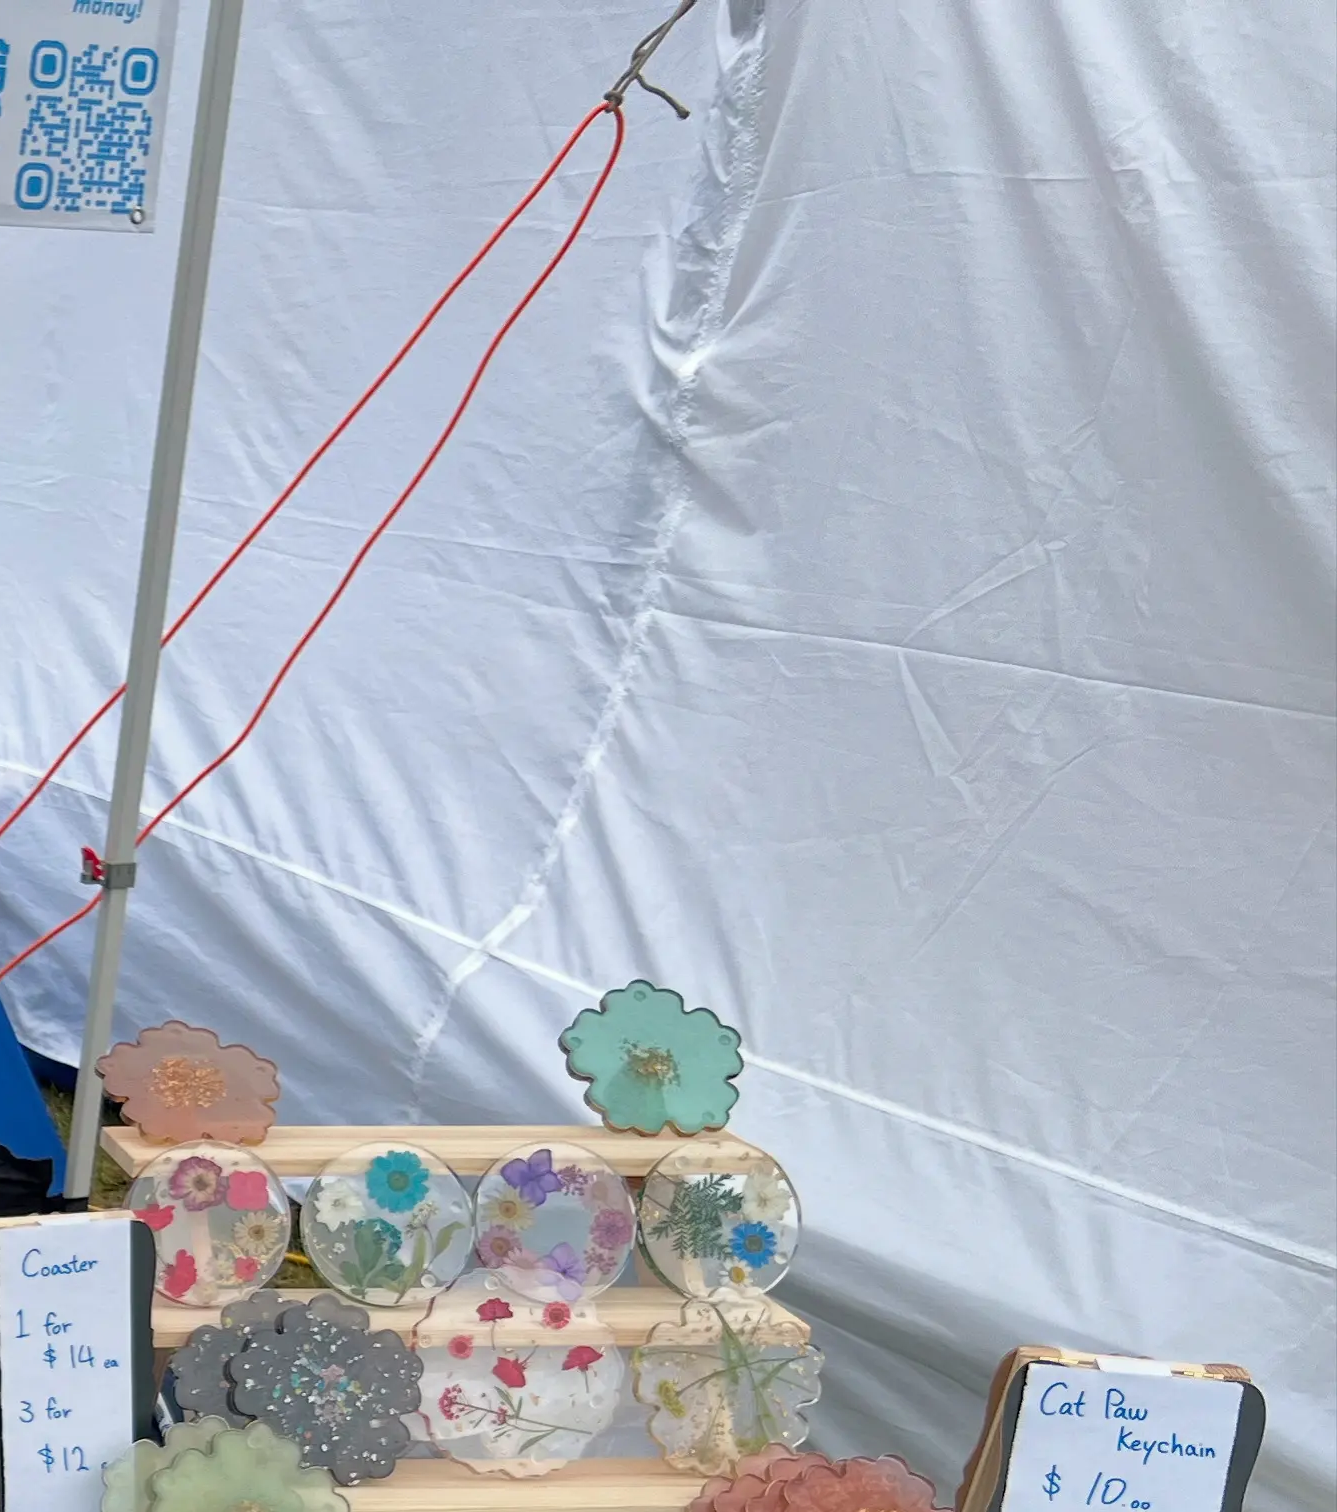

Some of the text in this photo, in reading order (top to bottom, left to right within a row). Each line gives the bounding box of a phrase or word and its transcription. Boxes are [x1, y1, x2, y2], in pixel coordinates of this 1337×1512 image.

[22, 1248, 98, 1278] Coaster
[15, 1310, 73, 1339] 1 for
[18, 1396, 72, 1424] 3 for
[1040, 1382, 1148, 1421] Cat Paw
[1116, 1426, 1216, 1465] Keychain
